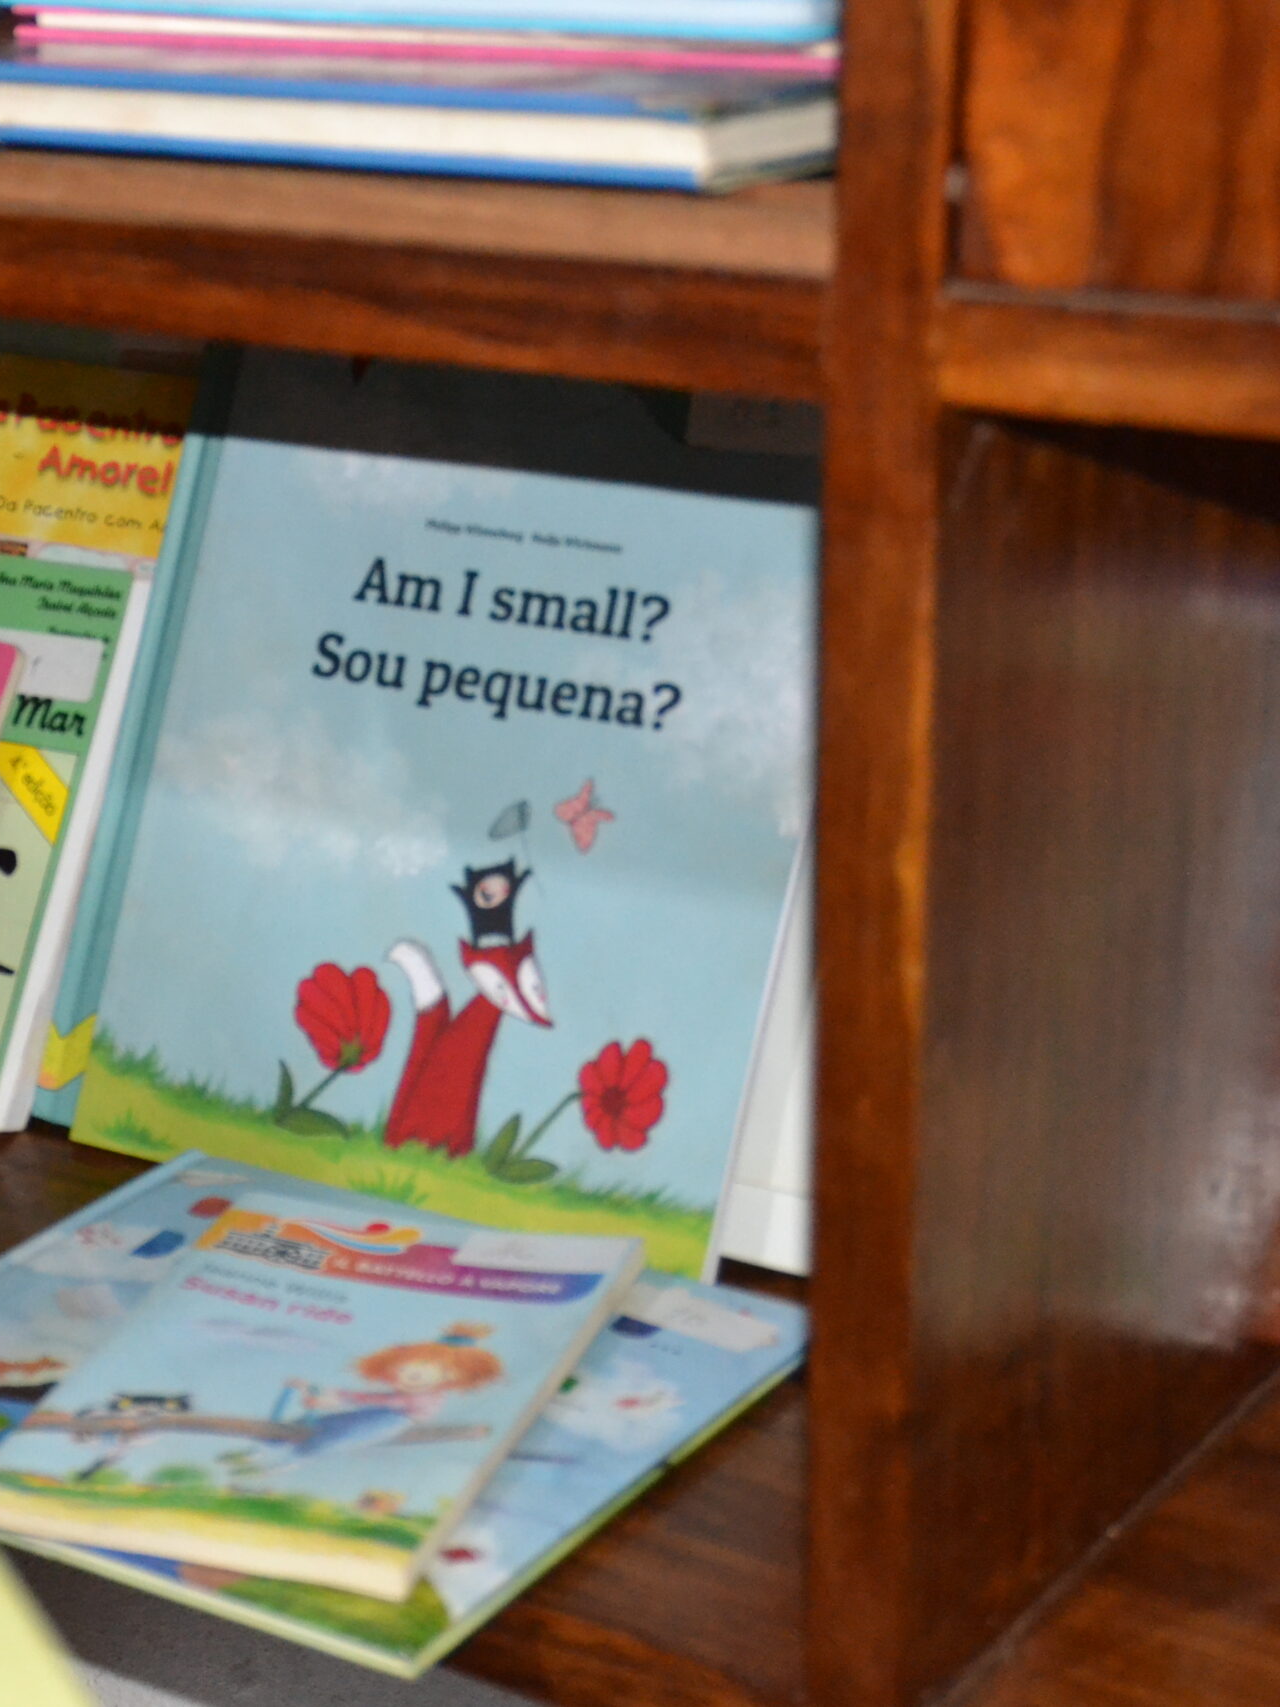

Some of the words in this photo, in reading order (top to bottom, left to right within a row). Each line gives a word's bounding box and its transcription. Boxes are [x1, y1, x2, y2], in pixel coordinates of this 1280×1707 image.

[354, 556, 443, 613] Am
[456, 570, 480, 617] I
[489, 587, 670, 643] small?
[12, 693, 86, 736] Mar
[312, 632, 407, 690] Sou
[415, 658, 682, 732] pequena?
